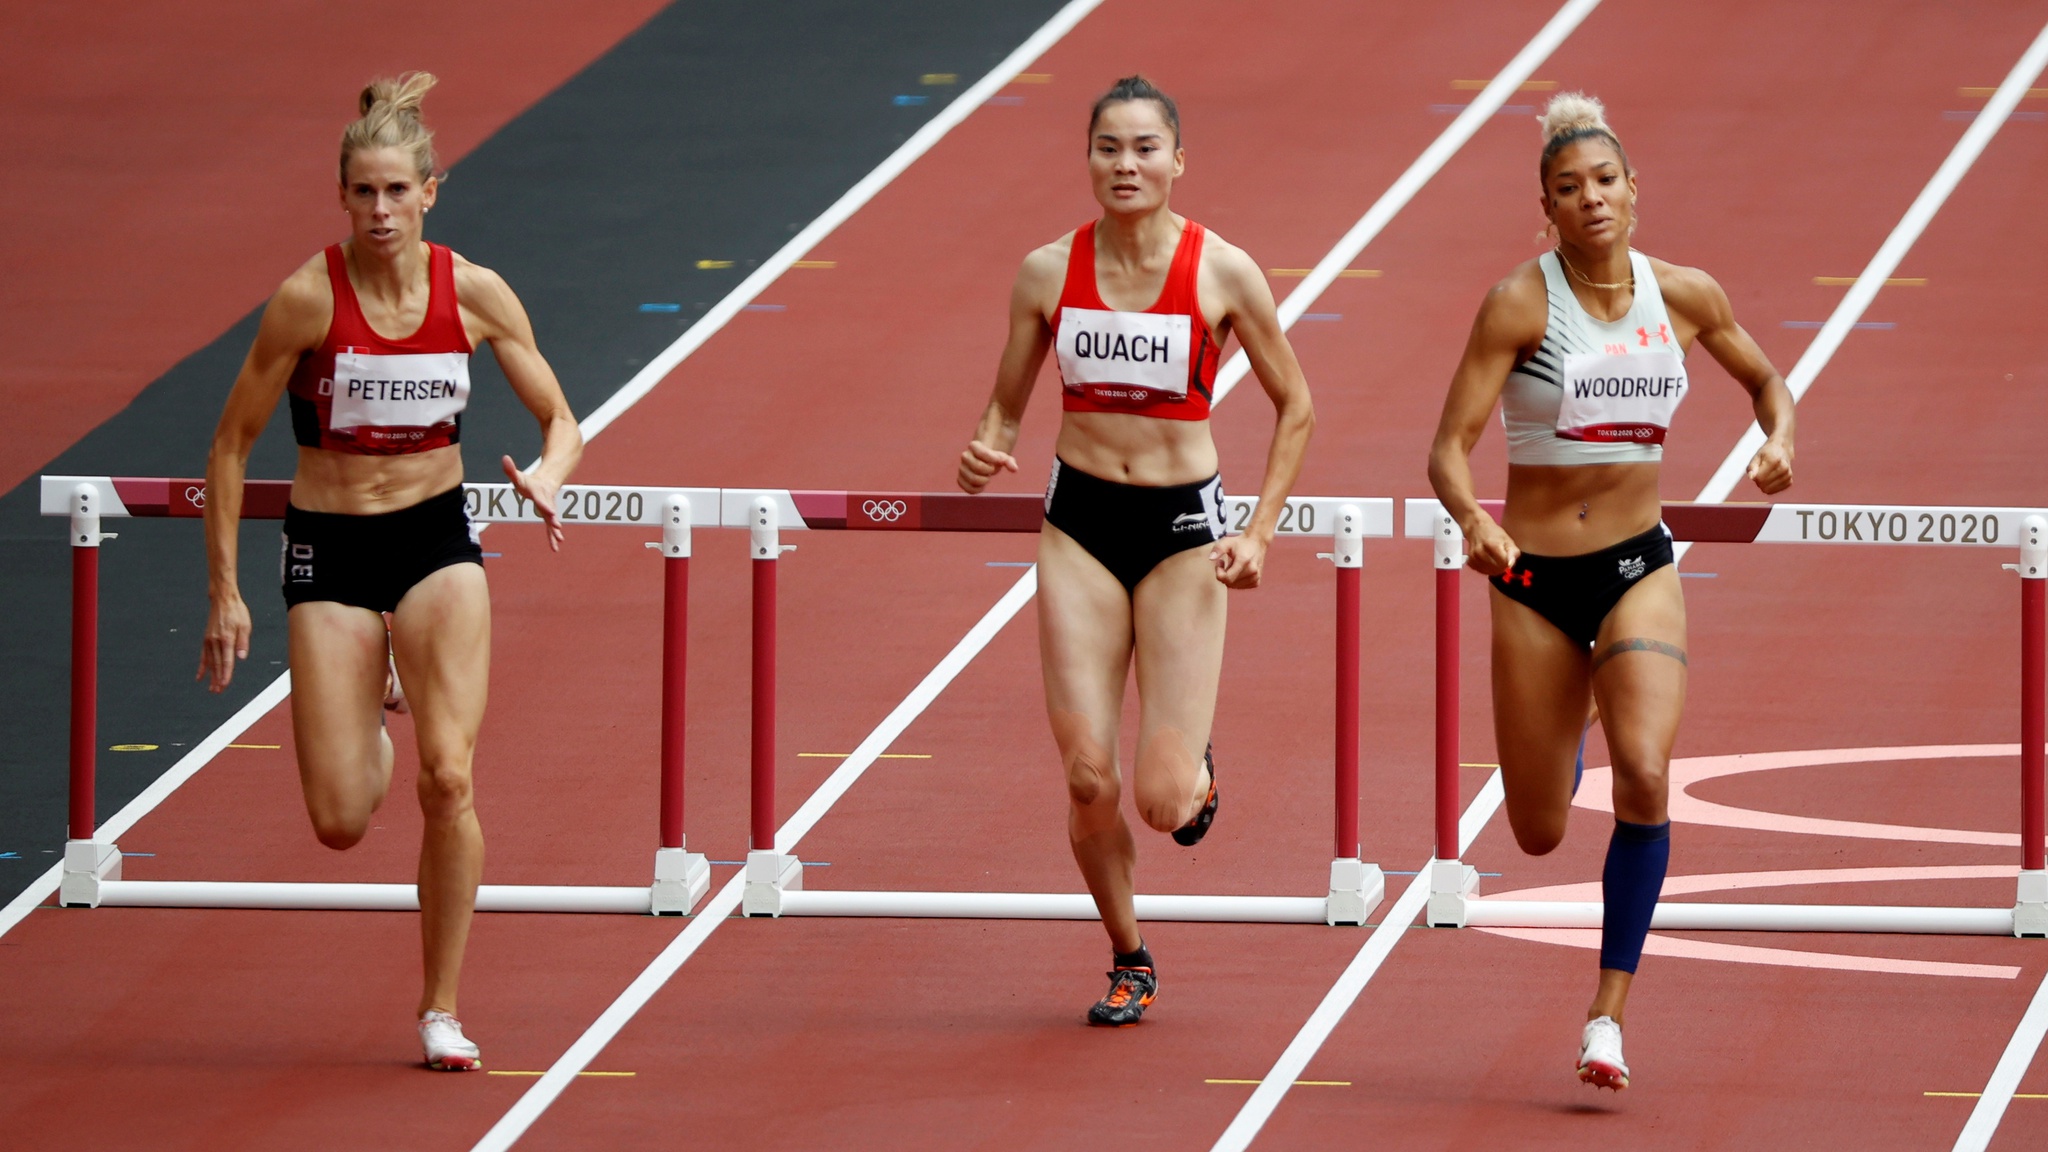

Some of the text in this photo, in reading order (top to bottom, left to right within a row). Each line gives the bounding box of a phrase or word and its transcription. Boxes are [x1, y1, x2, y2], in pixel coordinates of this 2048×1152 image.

[1075, 330, 1169, 363] QUACH
[1604, 343, 1628, 356] PAN
[348, 378, 457, 401] PETERSEN
[1094, 388, 1128, 398] TOKYO 2020
[1574, 376, 1683, 399] WOODRUFF
[1597, 429, 1633, 437] TOKYO 2020
[462, 487, 643, 521] OKY 2020
[1234, 501, 1315, 533] 220
[1796, 509, 1999, 544] TOKYO 2020
[1618, 559, 1646, 575] PANAMA
